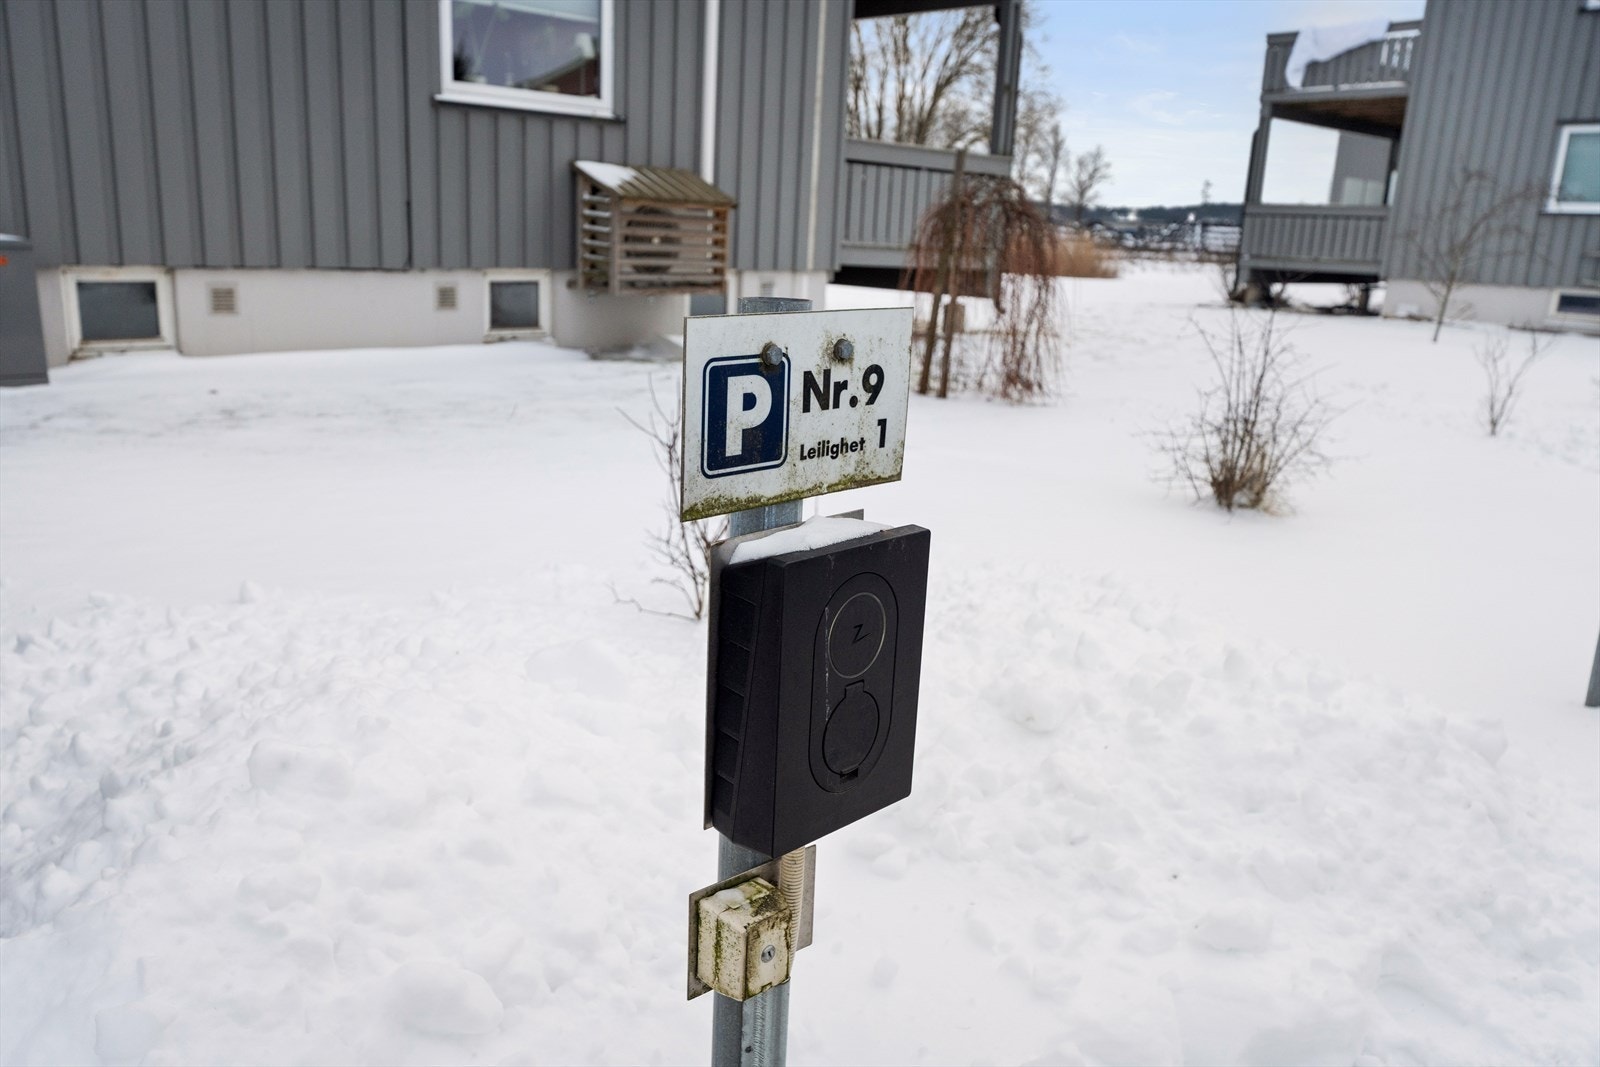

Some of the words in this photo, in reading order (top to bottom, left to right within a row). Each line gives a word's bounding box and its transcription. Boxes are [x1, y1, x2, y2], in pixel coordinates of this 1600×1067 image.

[802, 364, 885, 413] Nr.9
[725, 374, 772, 457] P
[799, 437, 866, 461] Leilighet
[877, 418, 888, 449] 1
